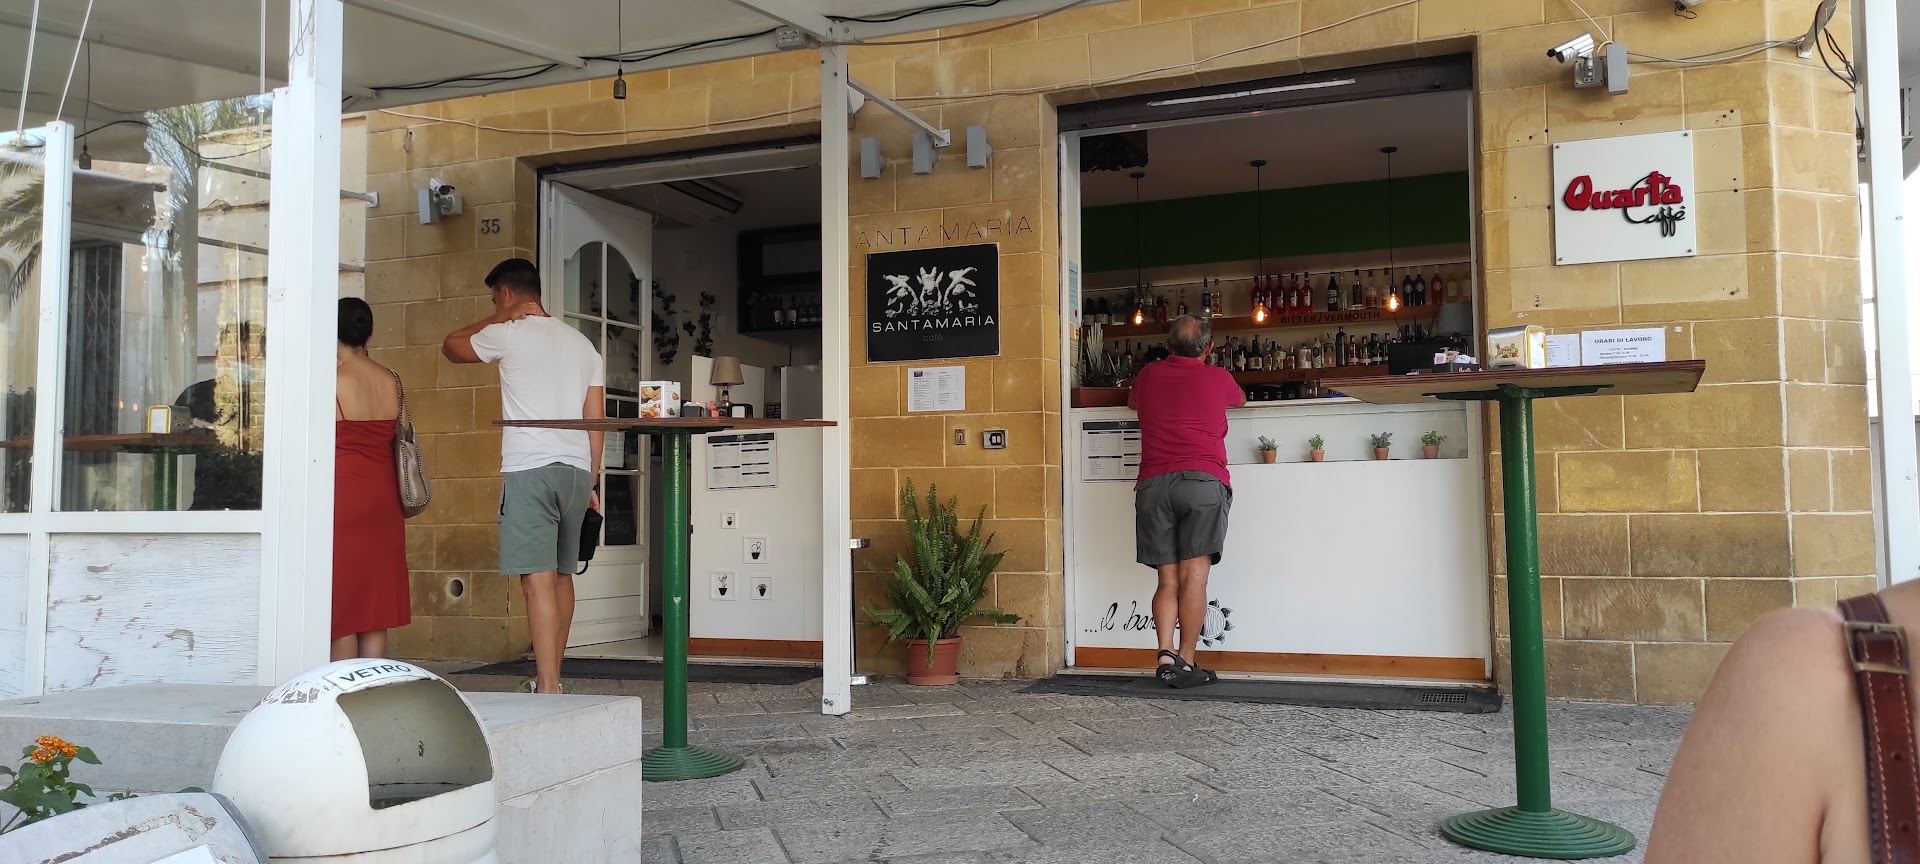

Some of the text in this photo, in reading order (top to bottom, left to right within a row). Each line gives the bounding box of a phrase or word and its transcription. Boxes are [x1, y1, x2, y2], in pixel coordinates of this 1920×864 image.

[1563, 170, 1684, 211] Quarta
[481, 218, 501, 235] 35
[855, 216, 1033, 249] ANTAMARIA
[872, 315, 995, 333] SANTAMARIA
[1288, 371, 1306, 379] GIN
[339, 664, 411, 681] VETRO
